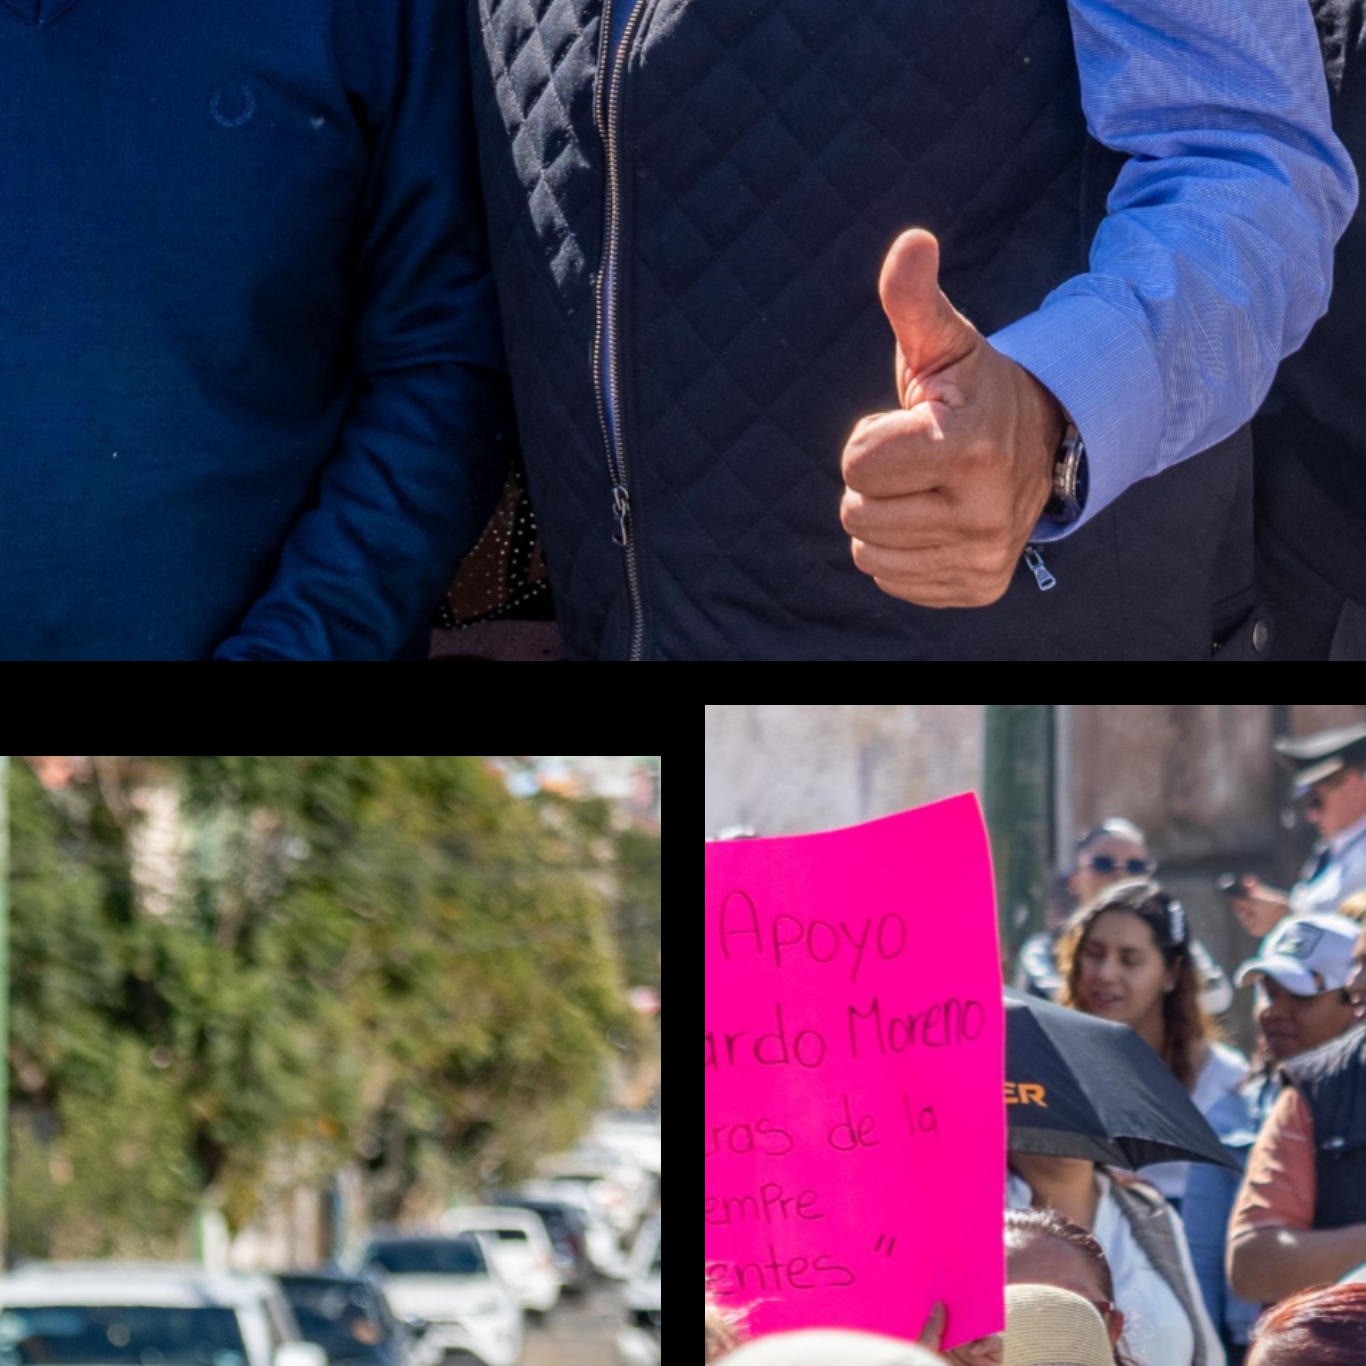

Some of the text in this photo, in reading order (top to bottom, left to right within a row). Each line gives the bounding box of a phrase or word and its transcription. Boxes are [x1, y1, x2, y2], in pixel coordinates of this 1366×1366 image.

[848, 995, 985, 1059] Moreno
[705, 1089, 939, 1158] ras de la
[1005, 1082, 1048, 1108] ER
